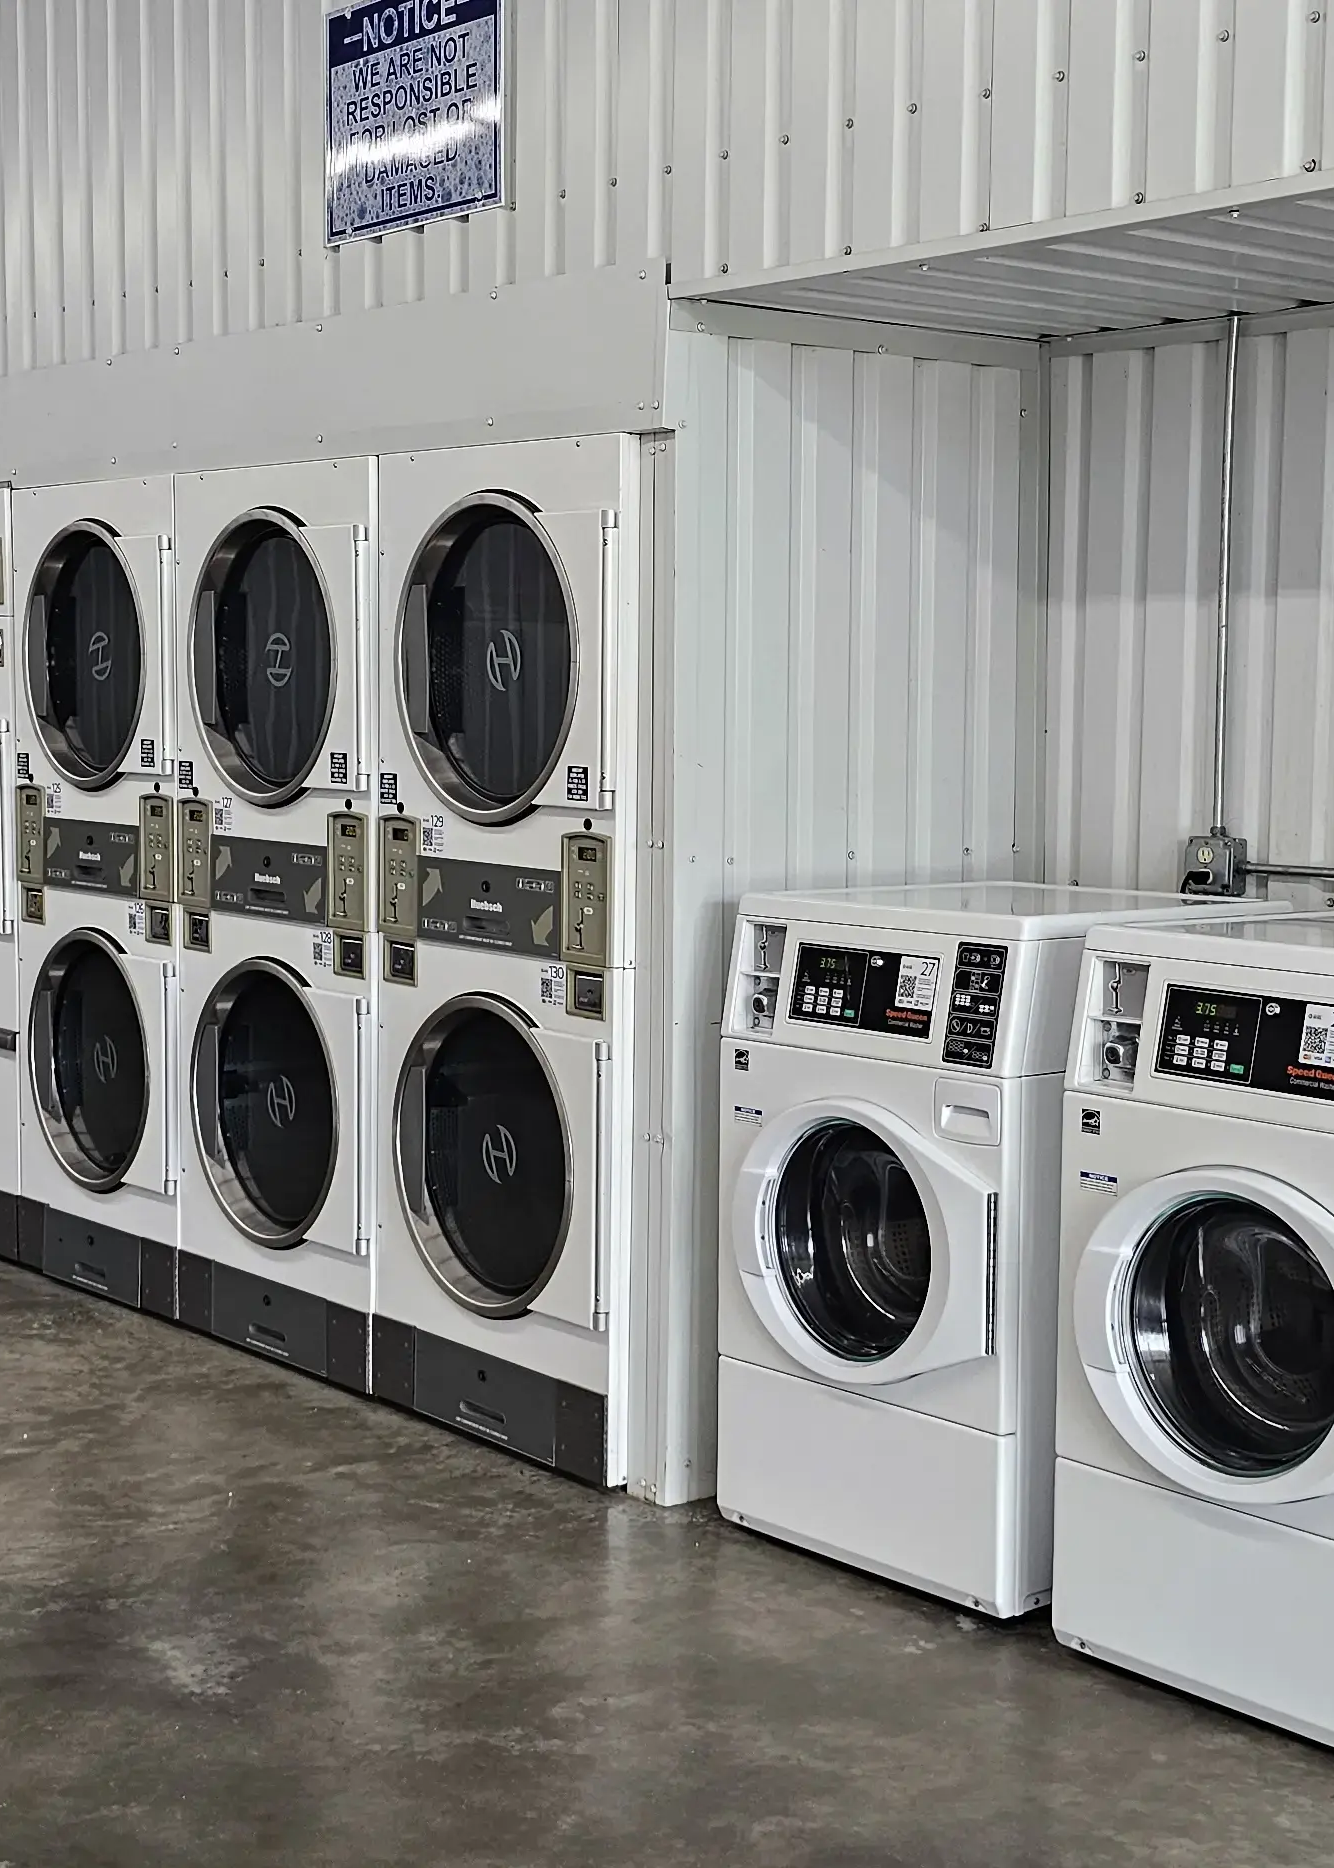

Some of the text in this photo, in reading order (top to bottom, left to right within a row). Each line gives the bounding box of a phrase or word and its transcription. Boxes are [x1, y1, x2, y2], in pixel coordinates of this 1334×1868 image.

[363, 0, 457, 51] NOTICE
[352, 32, 470, 92] WE ARE NOT
[346, 62, 478, 126] RESPONSIBLE
[380, 176, 441, 213] ITEMS.
[430, 814, 444, 828] 129
[470, 898, 503, 913] Huebsch
[320, 931, 332, 944] 128
[920, 961, 936, 977] 27
[1286, 1065, 1315, 1079] Speed
